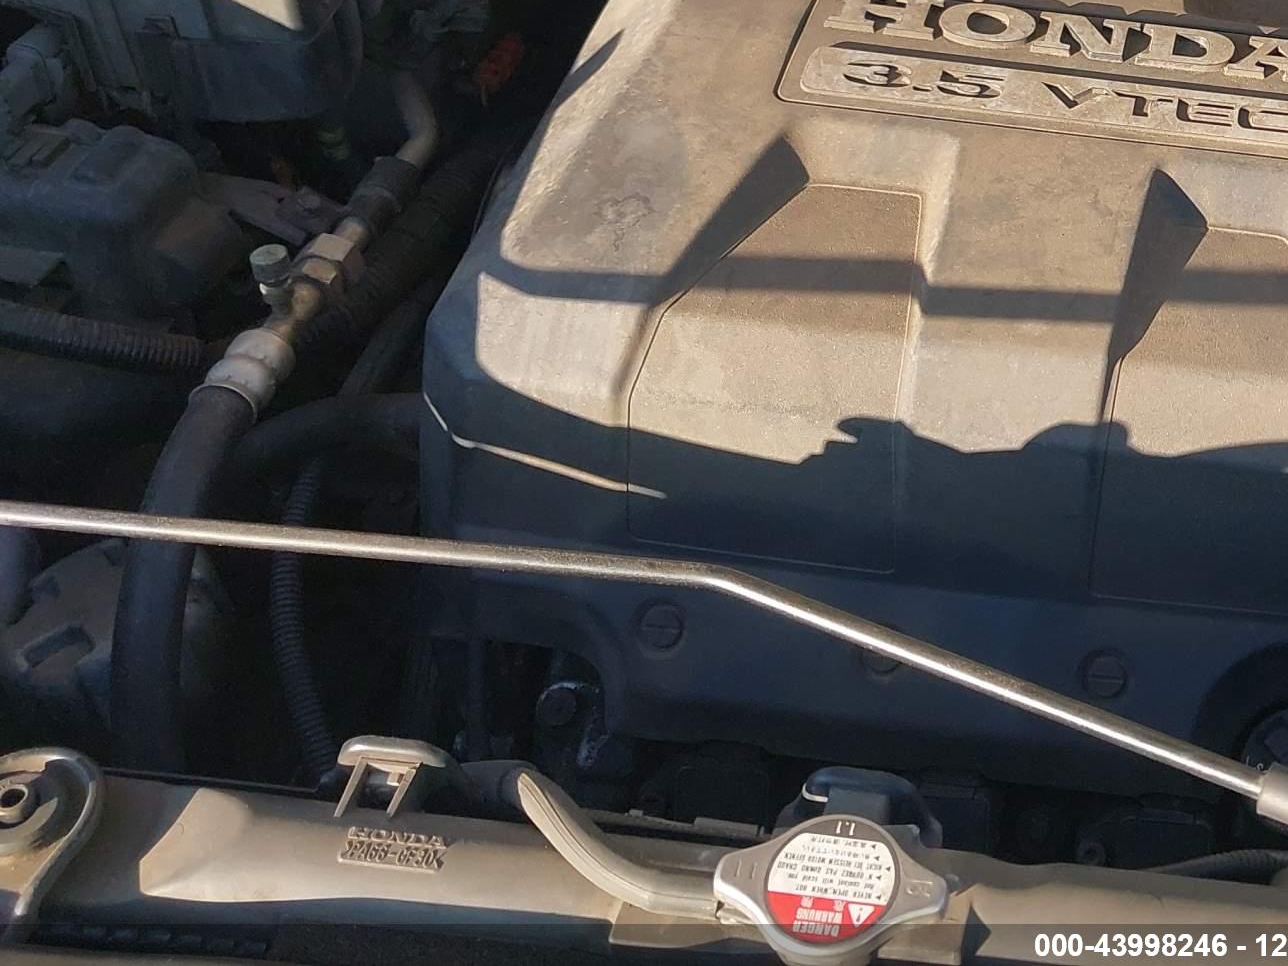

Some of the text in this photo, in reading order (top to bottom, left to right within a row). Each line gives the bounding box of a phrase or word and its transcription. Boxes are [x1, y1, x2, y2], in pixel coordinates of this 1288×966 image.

[843, 59, 1009, 100] 3.5
[795, 907, 843, 924] WARNUNG
[792, 920, 840, 938] DANGER
